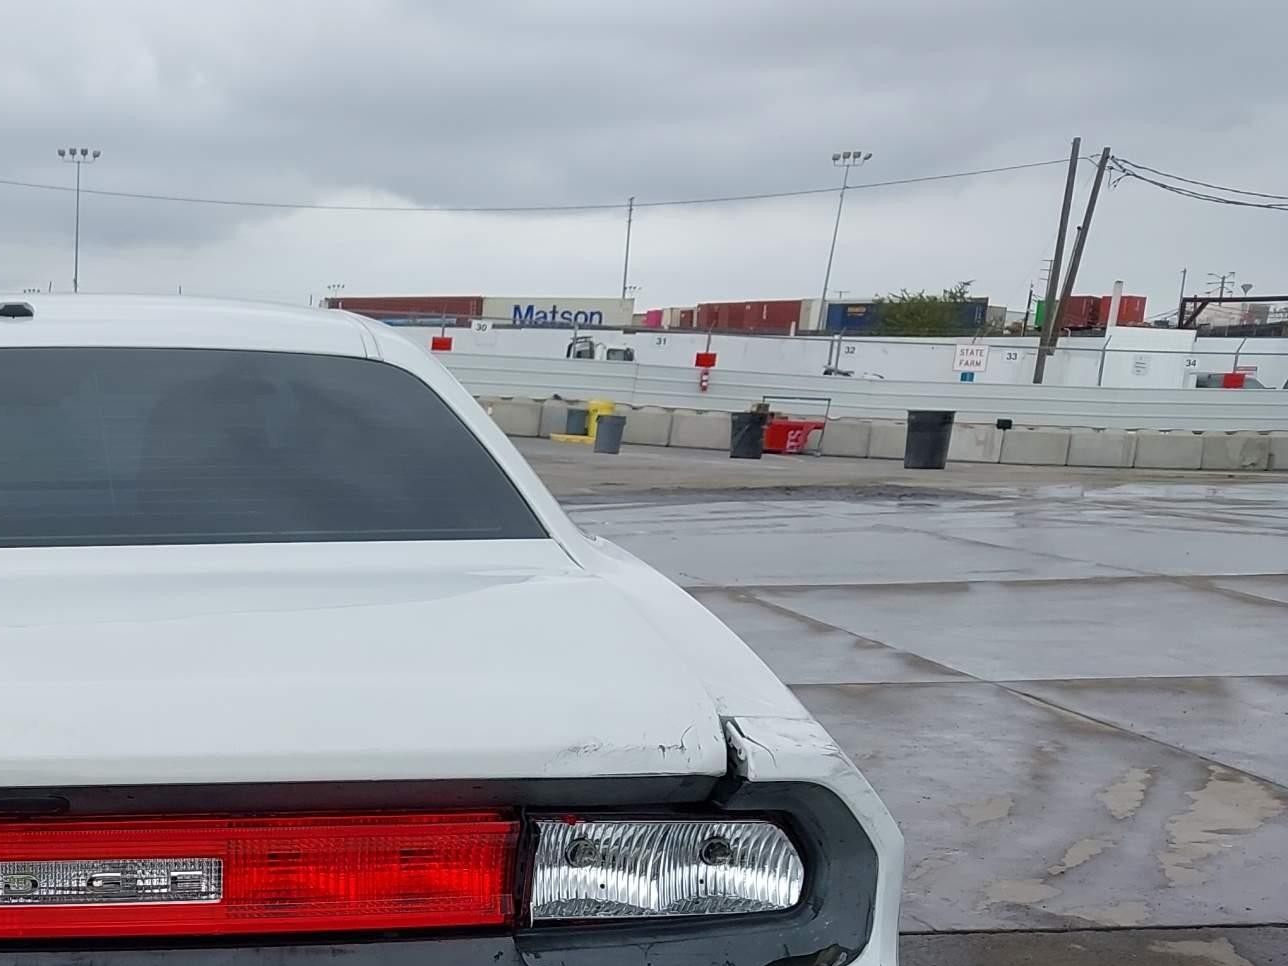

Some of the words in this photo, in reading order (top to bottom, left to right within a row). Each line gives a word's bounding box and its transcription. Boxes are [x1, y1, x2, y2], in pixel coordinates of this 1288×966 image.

[513, 304, 603, 325] Matson
[474, 321, 489, 333] 30
[654, 336, 668, 346] 31
[843, 345, 857, 355] 32
[959, 347, 985, 358] STATE
[1005, 351, 1019, 362] 33
[958, 358, 983, 368] FARM
[1184, 358, 1198, 368] 34
